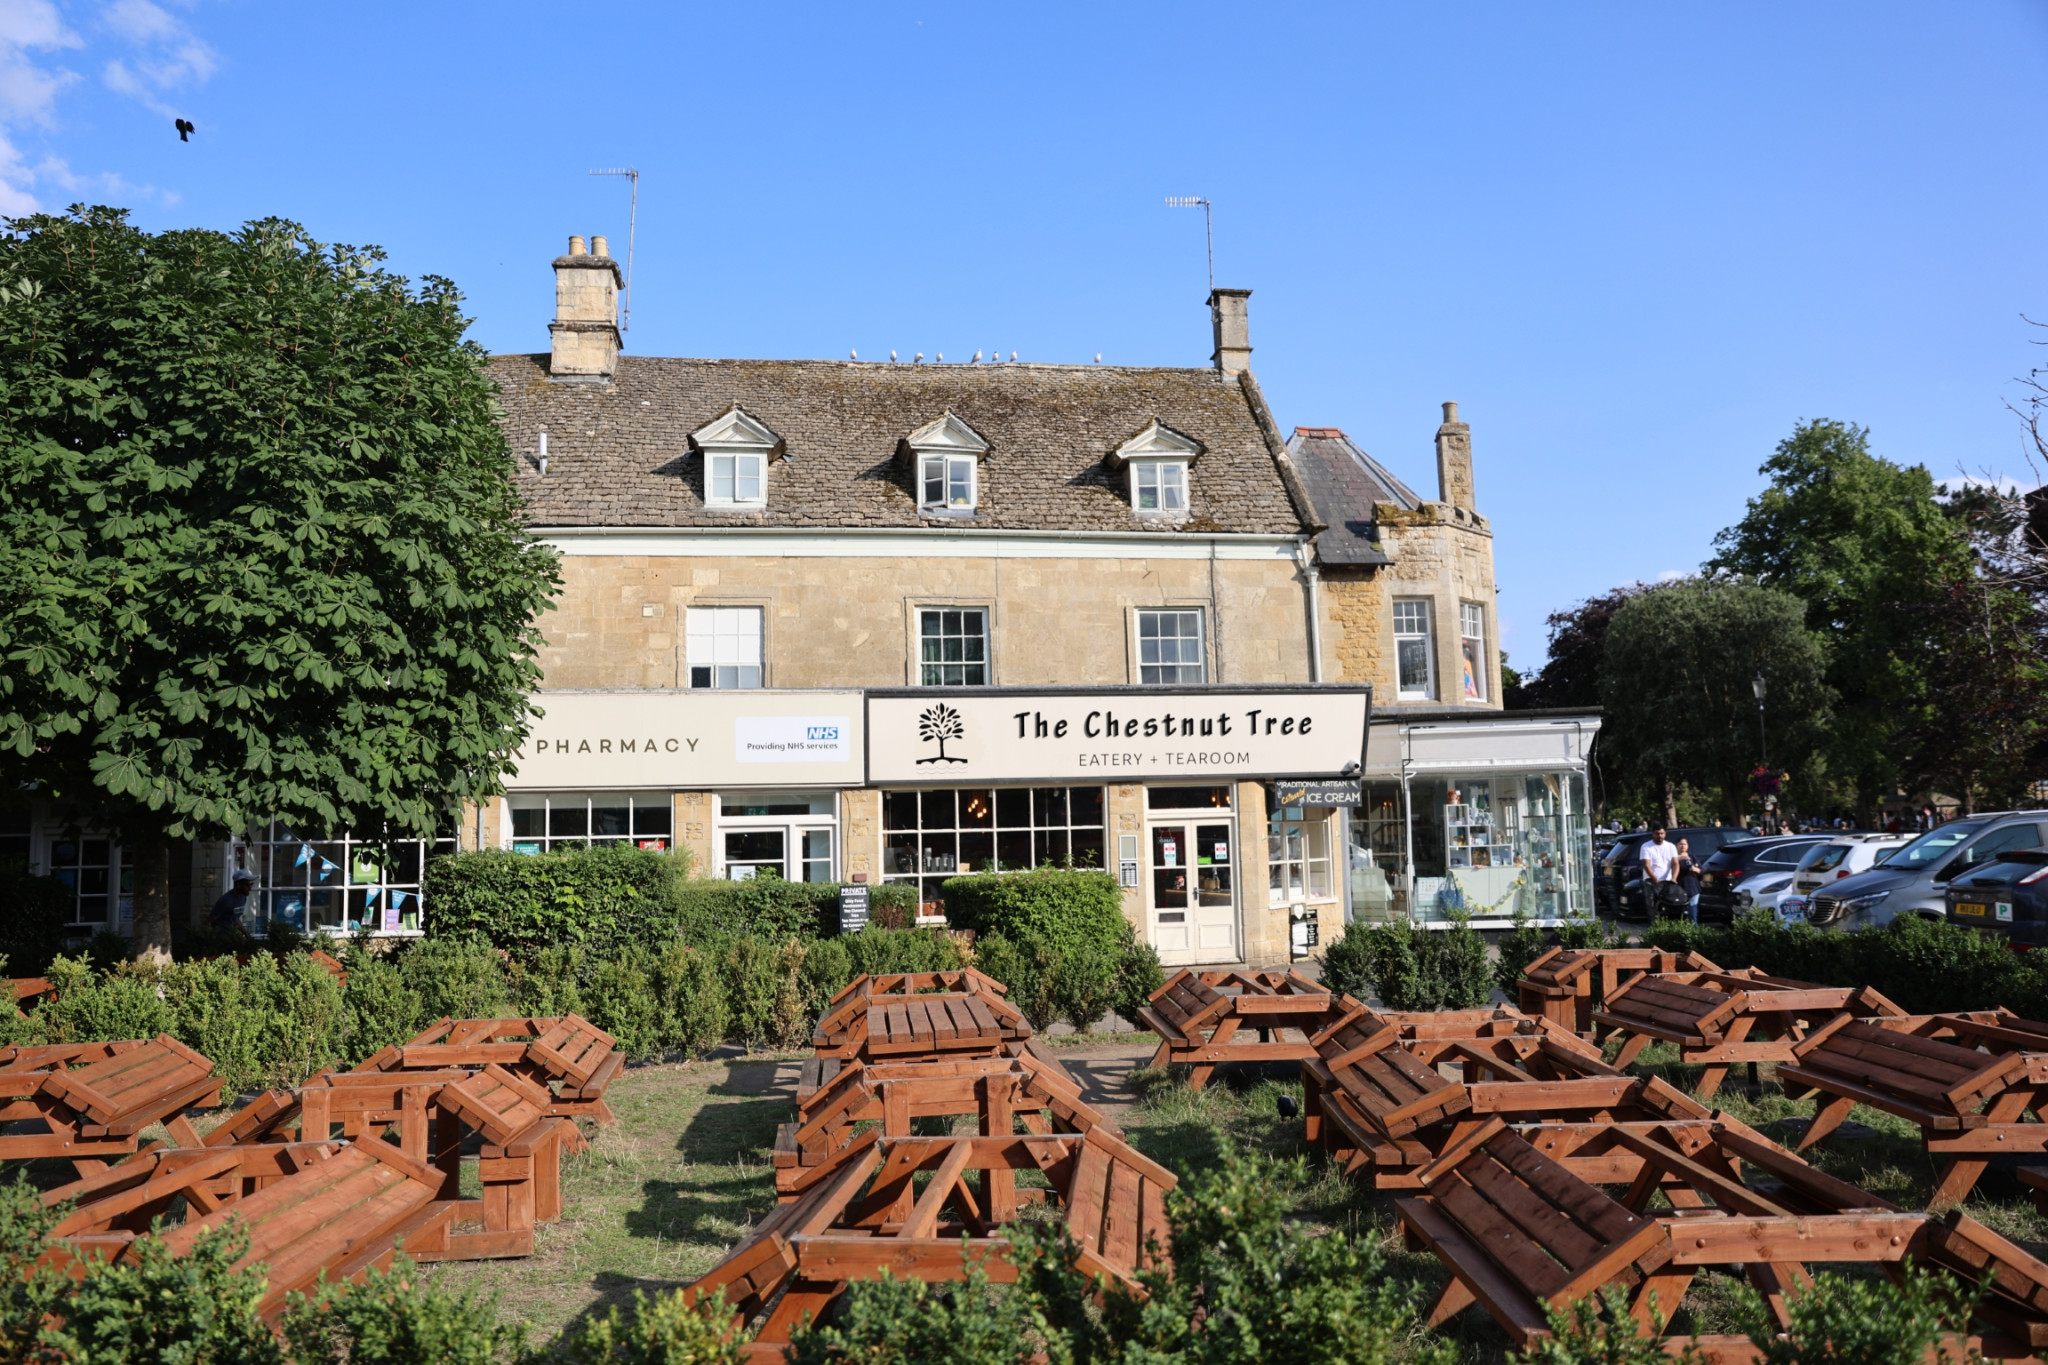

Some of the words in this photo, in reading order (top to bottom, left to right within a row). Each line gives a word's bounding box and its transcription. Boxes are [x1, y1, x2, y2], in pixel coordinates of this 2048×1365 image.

[1013, 711, 1069, 738] The
[1083, 710, 1233, 738] Chestnut
[1245, 709, 1313, 736] Tree
[808, 727, 837, 740] NHS
[536, 738, 699, 754] PHARMACY
[746, 742, 786, 752] Providing
[787, 742, 805, 751] NHS
[806, 741, 838, 750] services
[1079, 753, 1143, 767] EATERY
[1165, 751, 1251, 765] TEAROOM
[1280, 781, 1320, 789] TRADITIONAL
[1321, 780, 1348, 788] ARTISAN
[1306, 792, 1323, 803] ICE
[1324, 791, 1361, 803] CREAM
[1999, 904, 2008, 916] P
